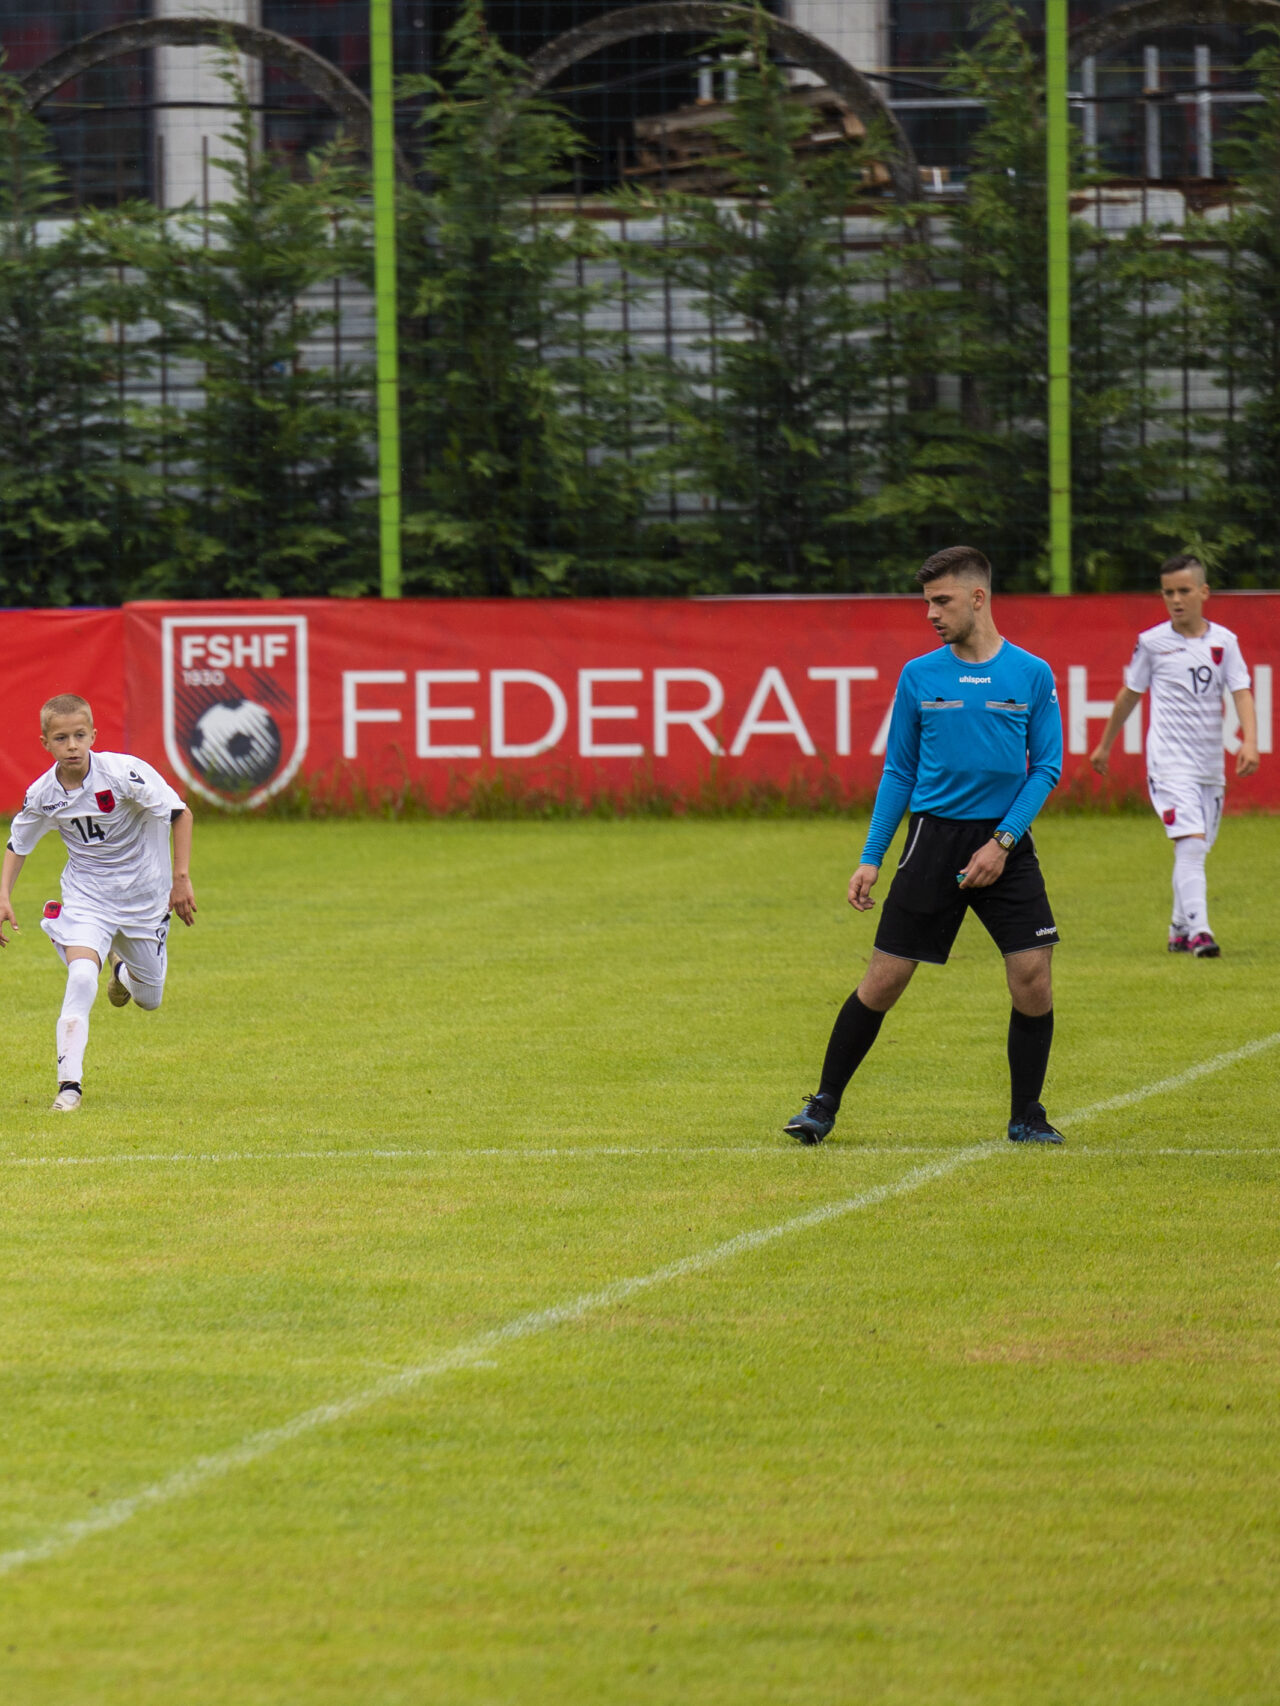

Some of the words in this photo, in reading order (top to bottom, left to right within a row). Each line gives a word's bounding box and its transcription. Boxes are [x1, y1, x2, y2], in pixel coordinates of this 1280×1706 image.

[181, 634, 289, 668] FSHF
[183, 669, 226, 686] 1930
[959, 675, 992, 685] uhlsport
[1188, 665, 1212, 694] 19
[342, 665, 897, 758] FEDERAT
[42, 801, 69, 812] macron
[71, 815, 106, 844] 14
